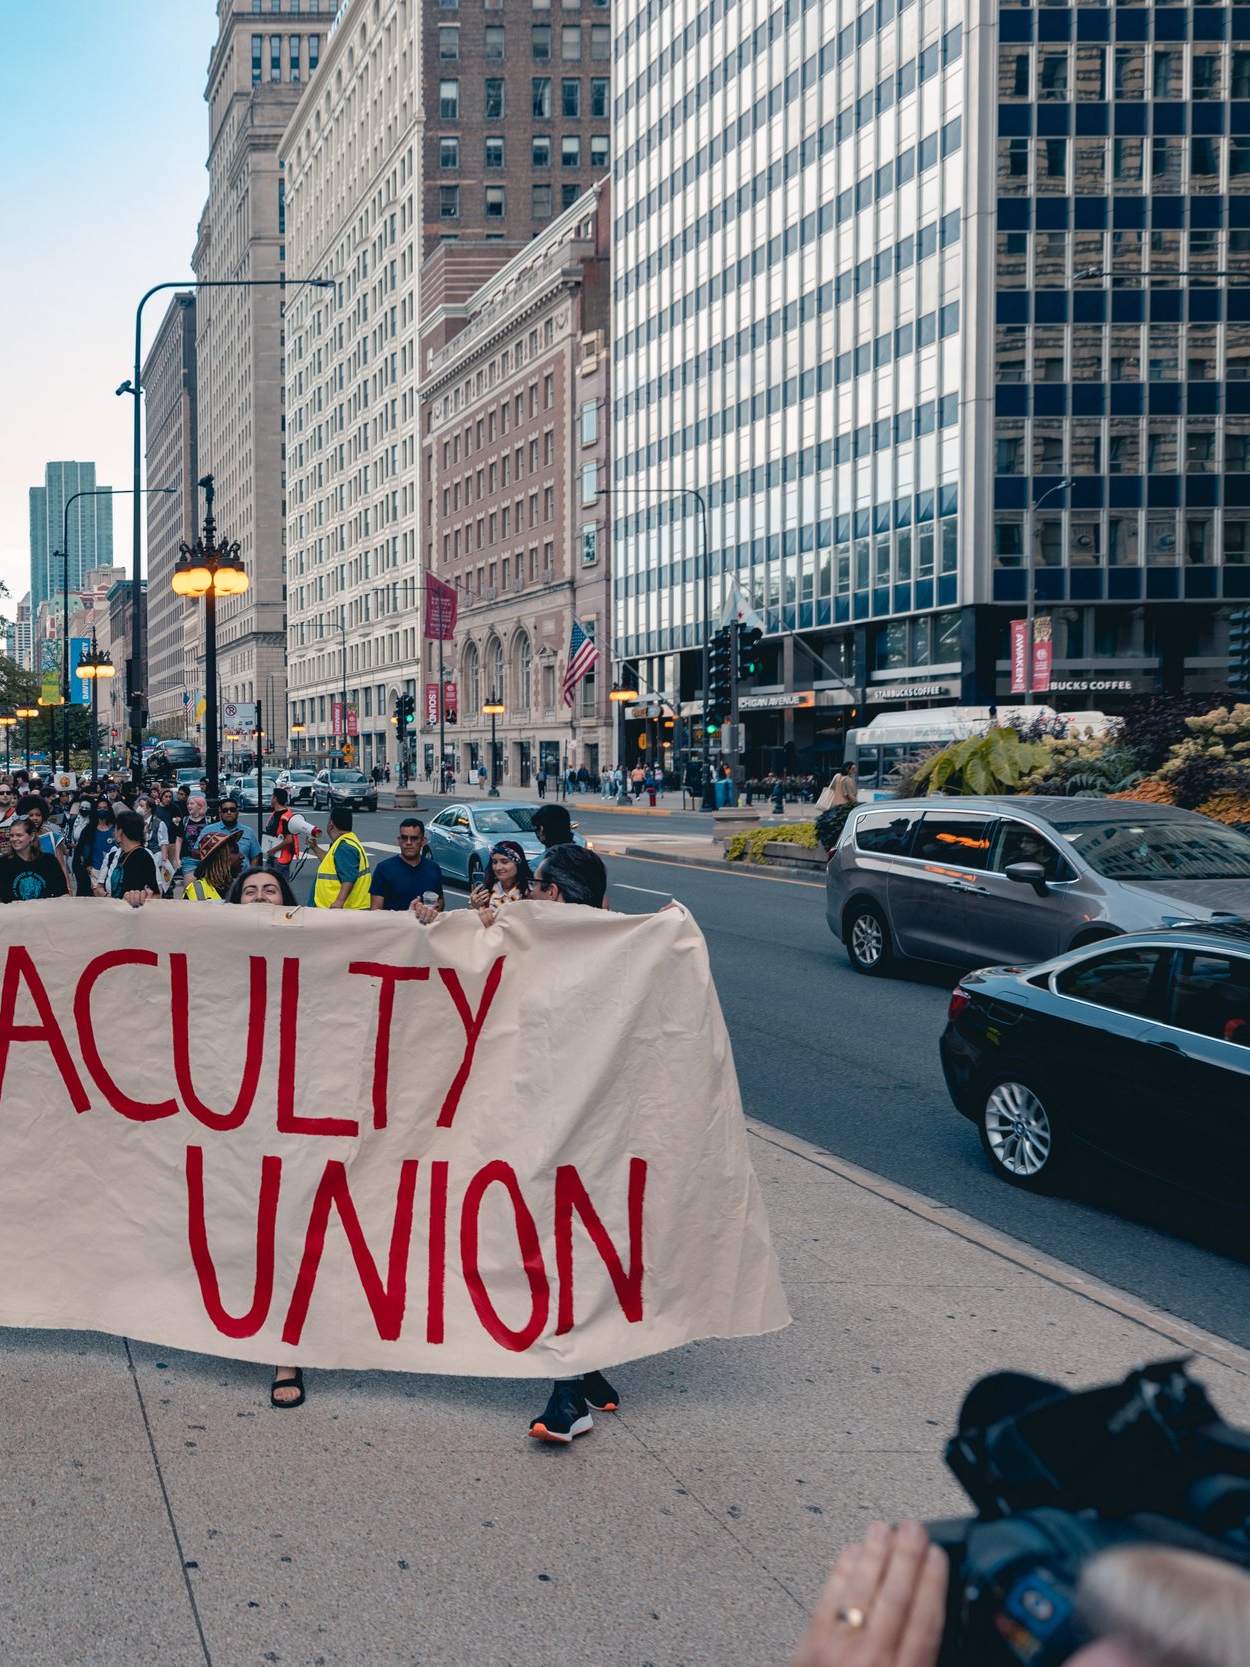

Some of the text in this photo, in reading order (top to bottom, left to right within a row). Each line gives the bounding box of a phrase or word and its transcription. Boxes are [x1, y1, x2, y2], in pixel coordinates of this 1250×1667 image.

[1015, 634, 1024, 682] AWAKEN
[874, 686, 940, 699] STARBUCKS COFFEE
[1049, 680, 1132, 691] BUCKS COFFEE
[739, 695, 800, 709] ICHIGAN AVENUE
[186, 1145, 647, 1352] UNION
